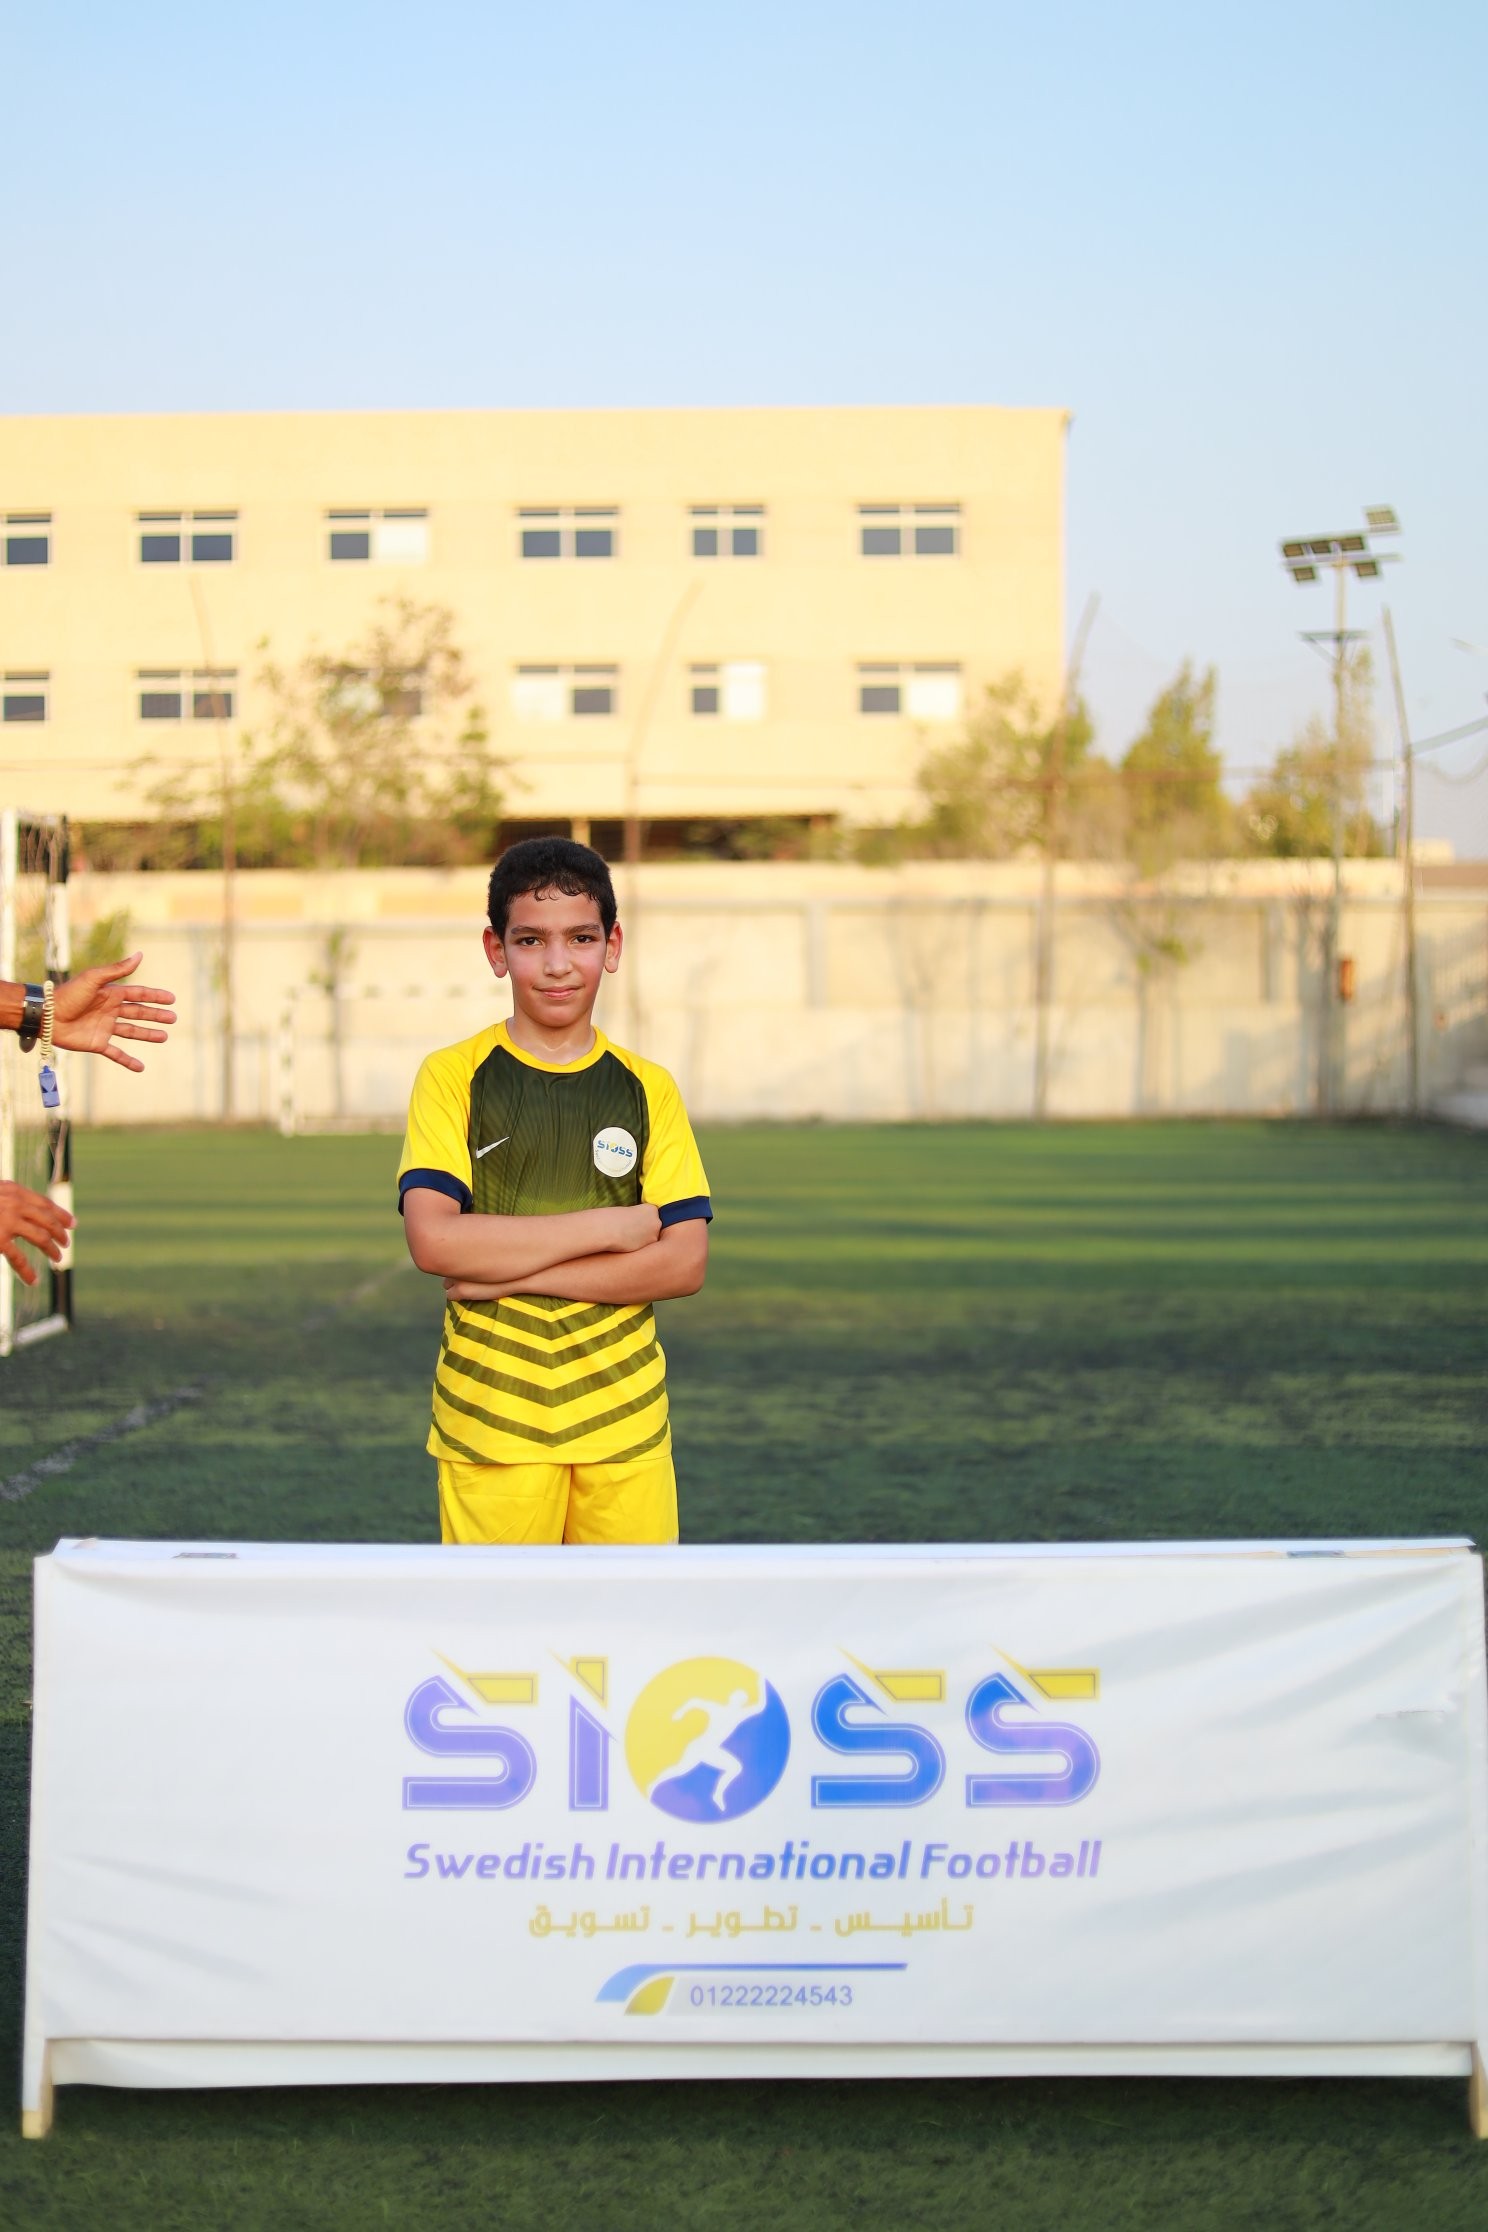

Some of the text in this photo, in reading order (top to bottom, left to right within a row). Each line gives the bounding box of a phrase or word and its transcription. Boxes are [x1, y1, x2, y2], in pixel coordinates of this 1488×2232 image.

[403, 1840, 1102, 1880] Swedish International Football
[689, 1985, 853, 2008] 01222224543
